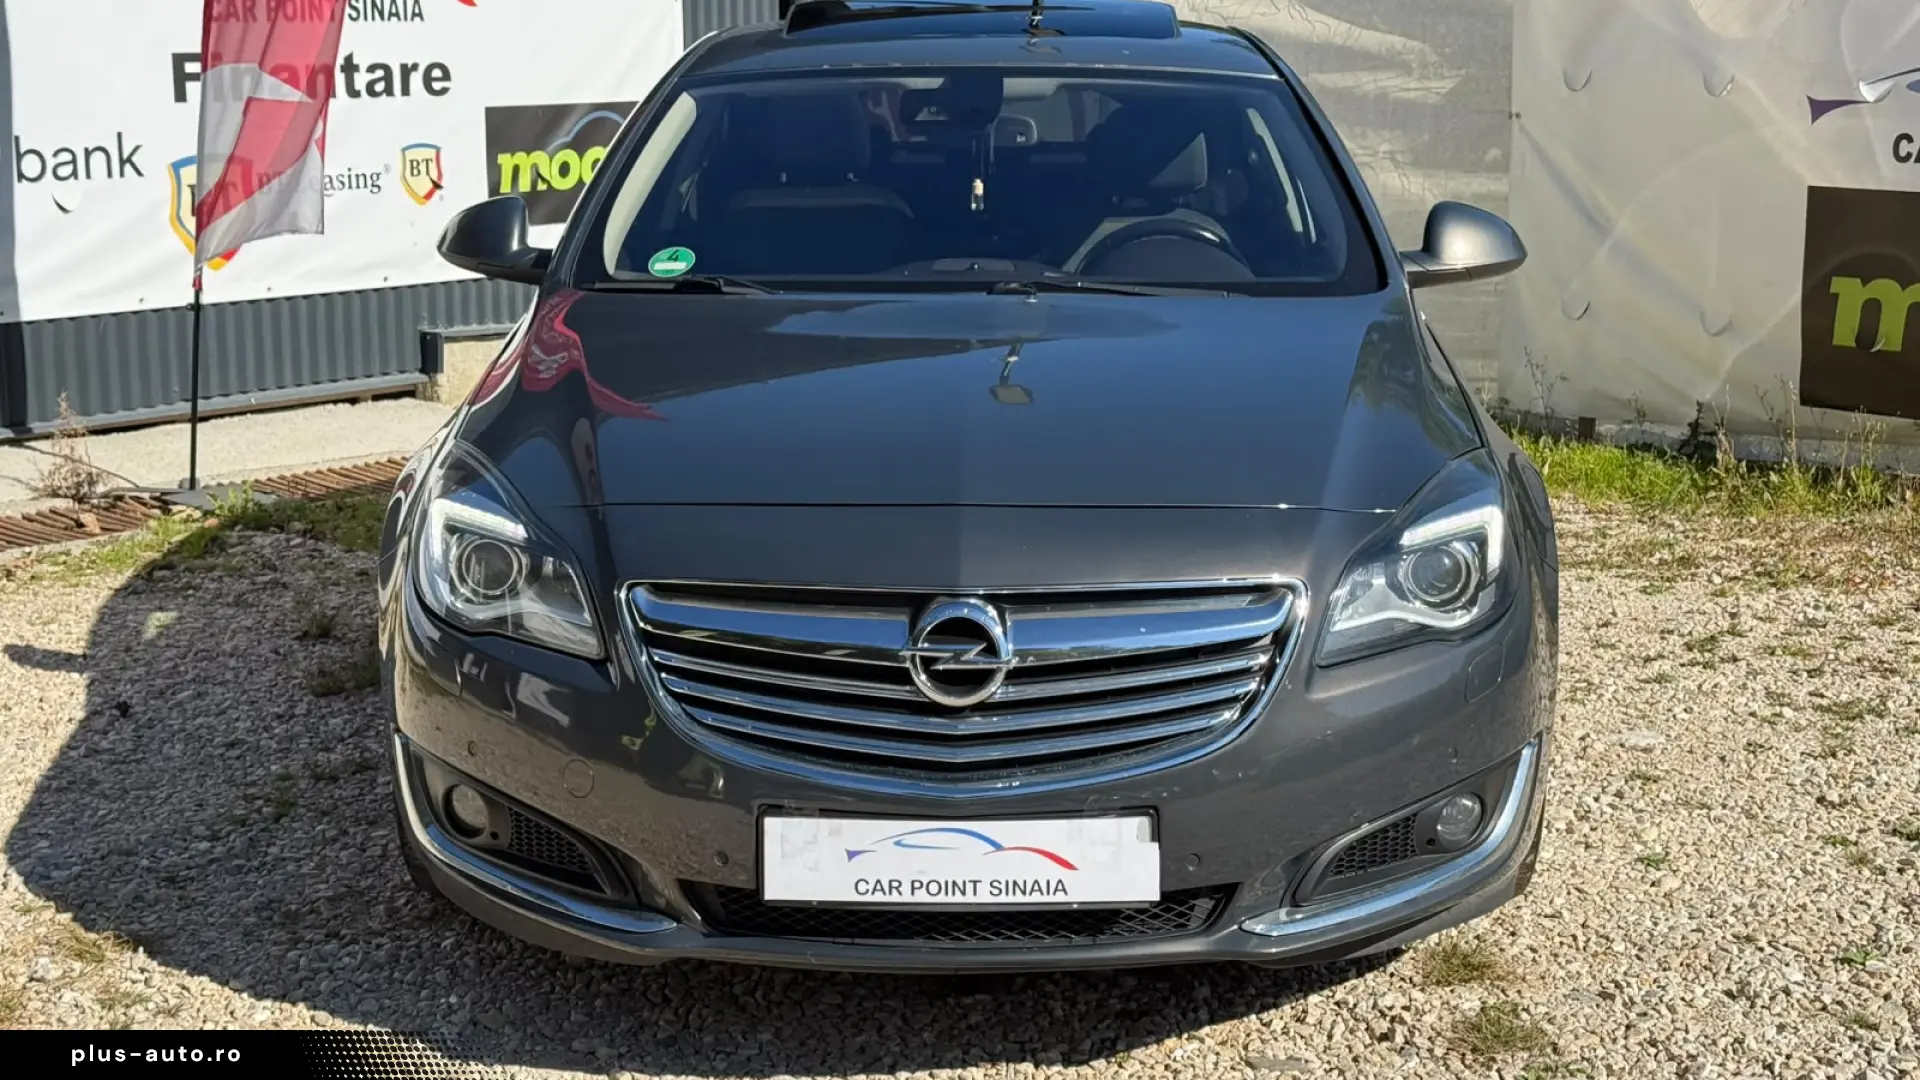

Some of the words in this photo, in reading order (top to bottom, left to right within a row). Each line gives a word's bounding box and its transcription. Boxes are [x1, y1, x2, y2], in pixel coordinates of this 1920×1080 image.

[347, 0, 424, 22] SINAIA
[13, 131, 144, 183] bank
[408, 157, 433, 177] BT
[666, 249, 680, 262] 4
[854, 878, 903, 896] CAR
[910, 879, 982, 897] POINT
[989, 879, 1068, 897] SINAIA
